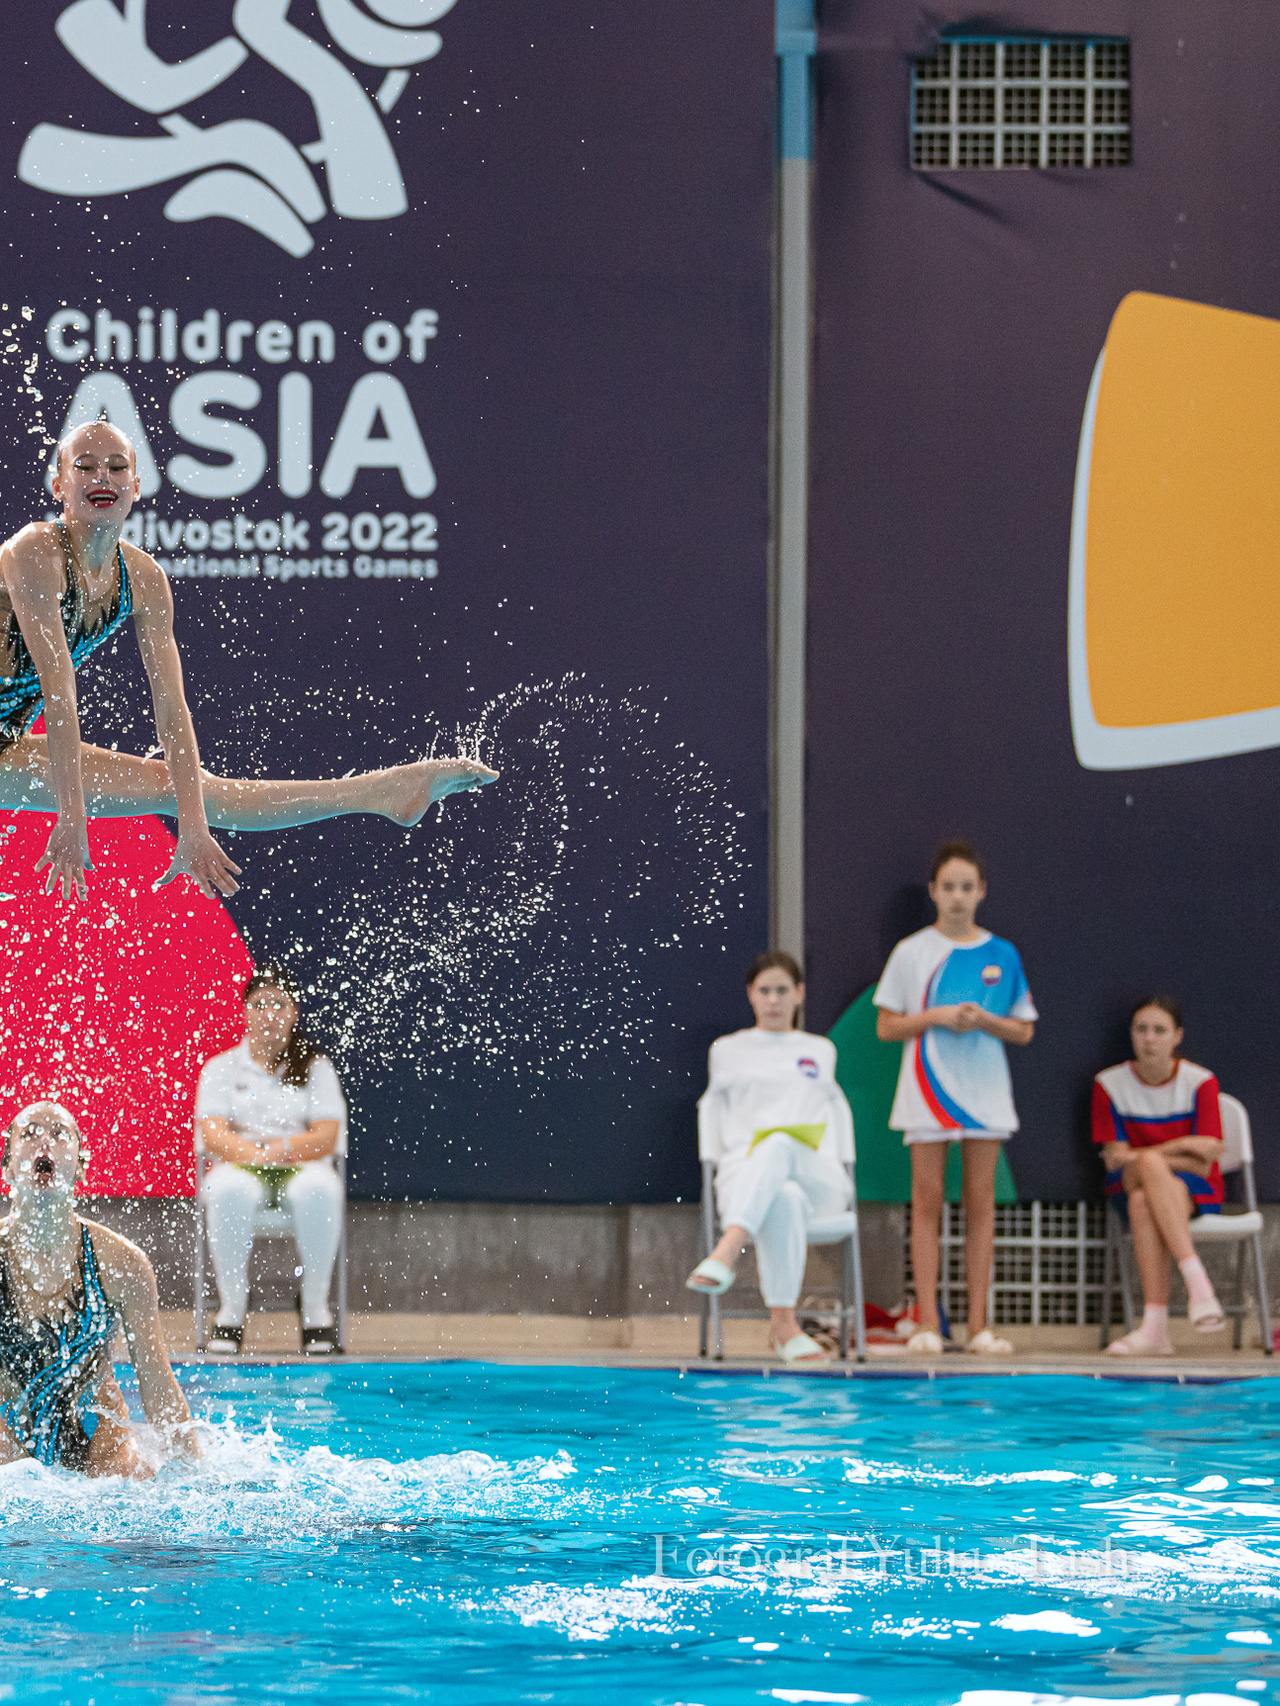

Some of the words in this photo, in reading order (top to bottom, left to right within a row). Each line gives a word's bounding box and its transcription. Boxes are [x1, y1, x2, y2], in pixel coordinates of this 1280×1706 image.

[45, 306, 336, 363] Children
[362, 308, 439, 363] of
[43, 370, 438, 499] ASIA
[45, 510, 311, 552] divostok
[321, 511, 439, 552] 2022
[262, 555, 349, 583] Sports
[353, 555, 439, 579] Games
